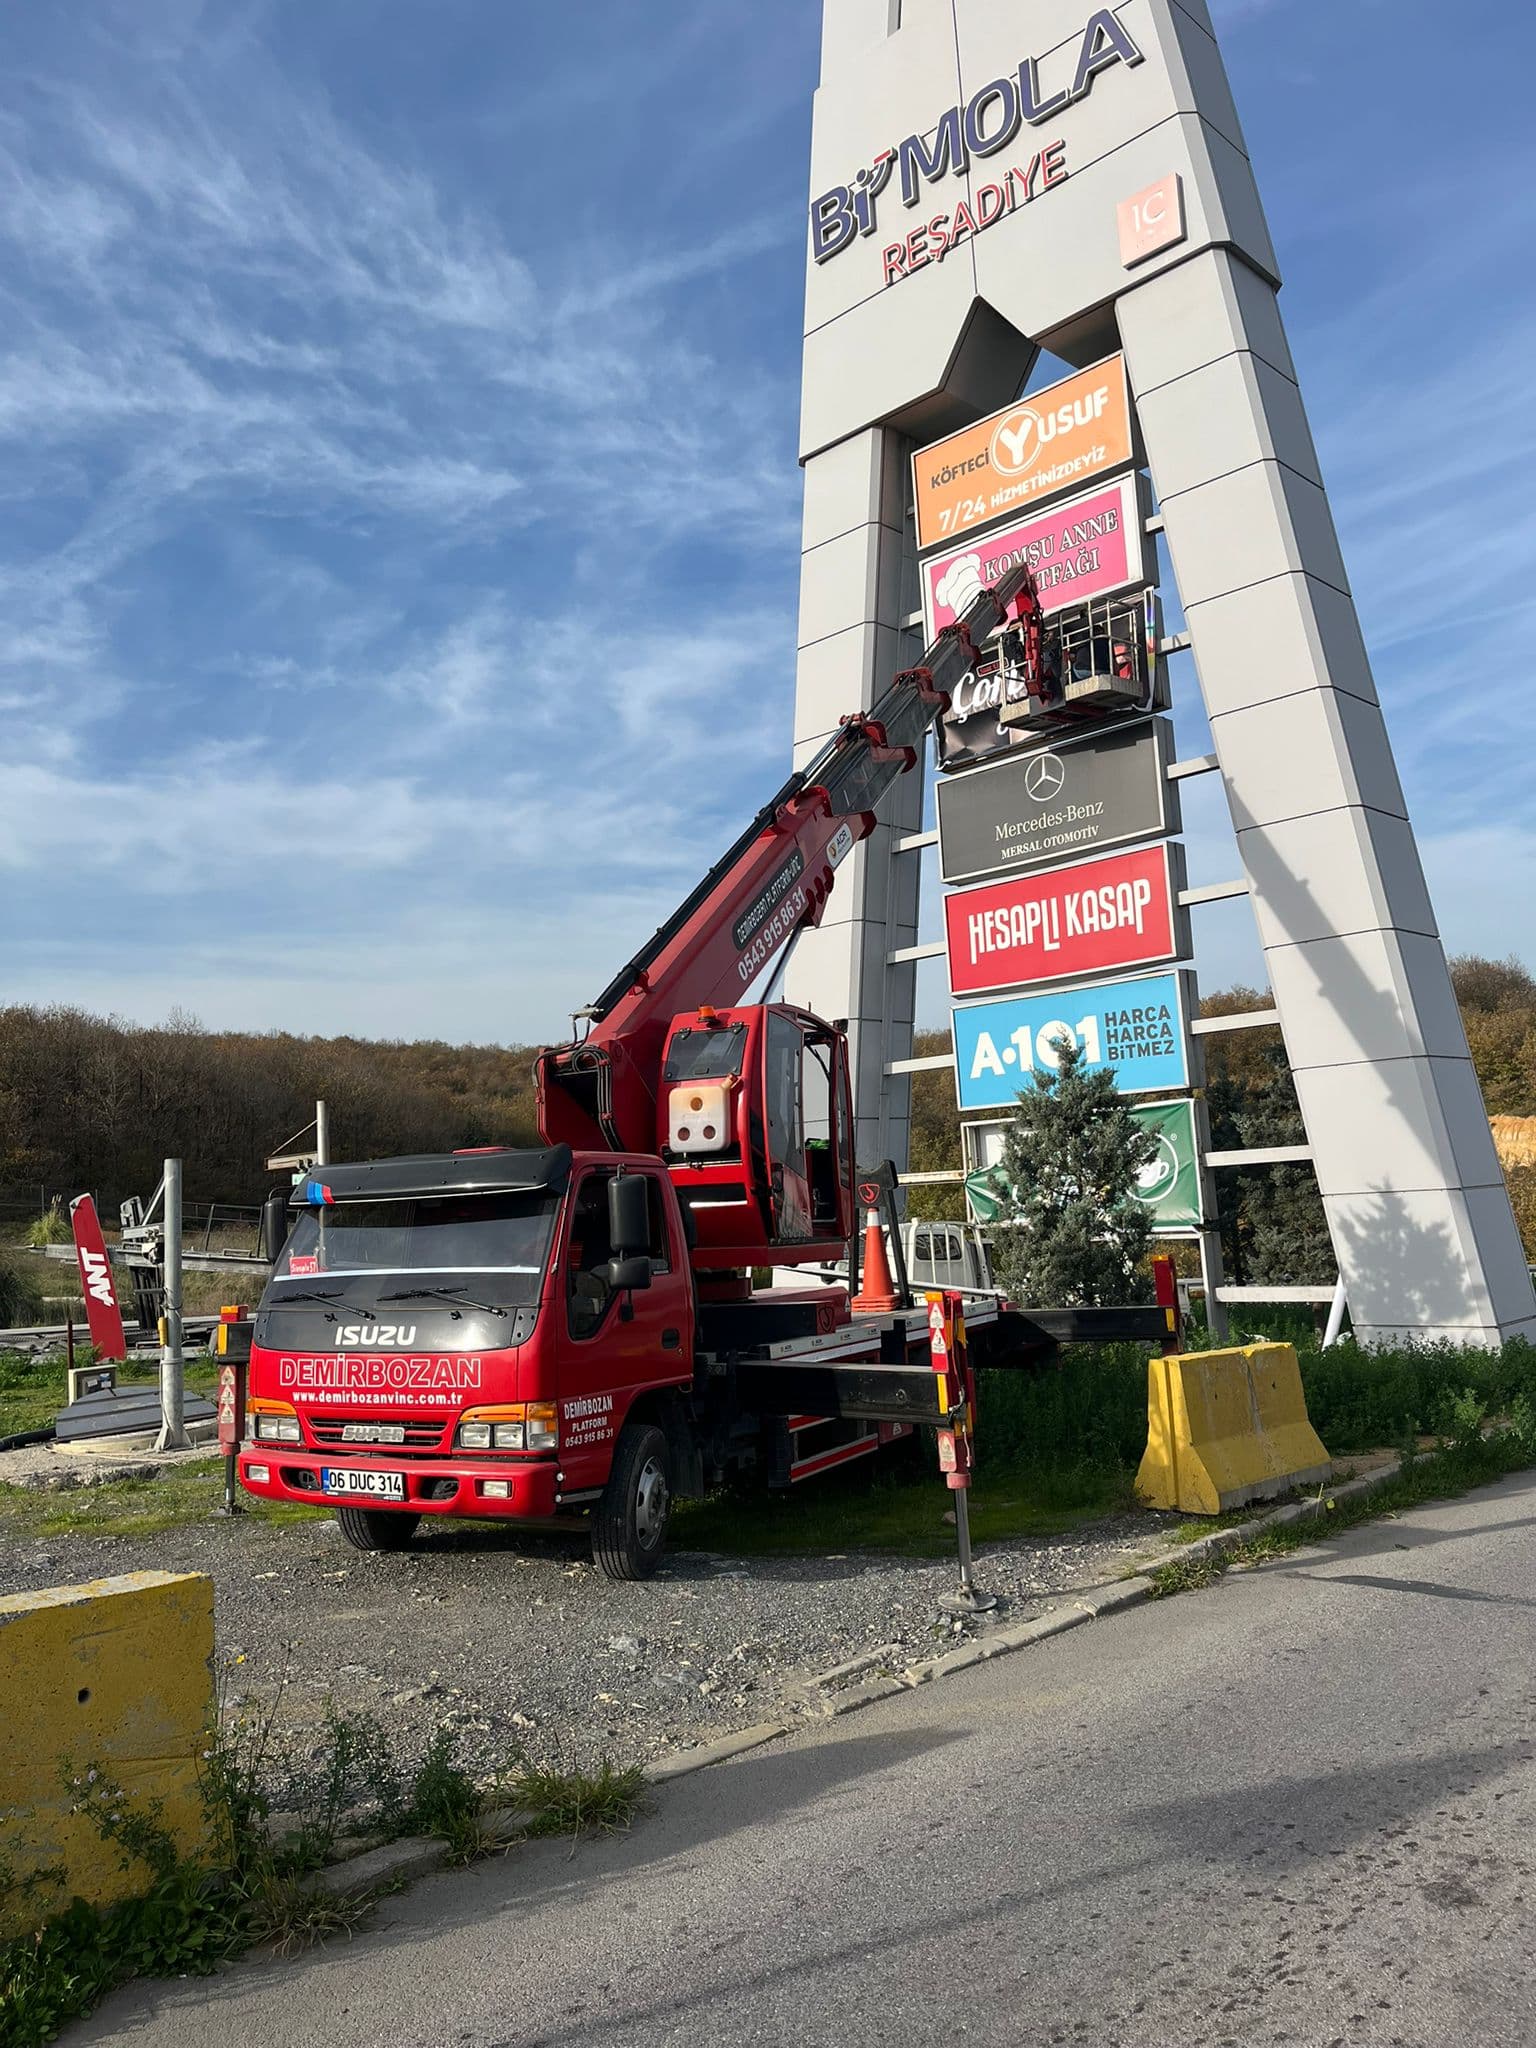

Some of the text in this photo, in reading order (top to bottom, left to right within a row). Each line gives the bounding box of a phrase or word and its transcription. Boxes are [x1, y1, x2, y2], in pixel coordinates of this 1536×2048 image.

[931, 447, 990, 488] KÖFTECİ
[938, 445, 1106, 532] 7/24 HİZMETİNİZDEYİZ
[984, 509, 1119, 582] KOMŞU ANNE
[1034, 547, 1100, 591] TFAĞI
[995, 801, 1104, 841] Mercedes-Benz
[1001, 825, 1099, 860] MERSAL OTOMOTİV
[737, 886, 806, 981] 0543 915 86 31
[969, 878, 1150, 964] HESAPLI KASAP
[1104, 1005, 1171, 1028] HARCA
[1106, 1022, 1173, 1045] HARCA
[80, 1246, 115, 1307] ANT
[335, 1326, 416, 1346] ISUZU
[279, 1353, 481, 1388] DEMİRBOZAN
[292, 1390, 463, 1405] www.demirbozanvinc.com.tr
[564, 1395, 613, 1419] DEMİRBOZAN
[341, 1425, 405, 1443] SUPER
[565, 1428, 613, 1447] 0543 915 86 31
[572, 1416, 607, 1432] PLATFORM
[329, 1472, 401, 1492] 06 DUC 314
